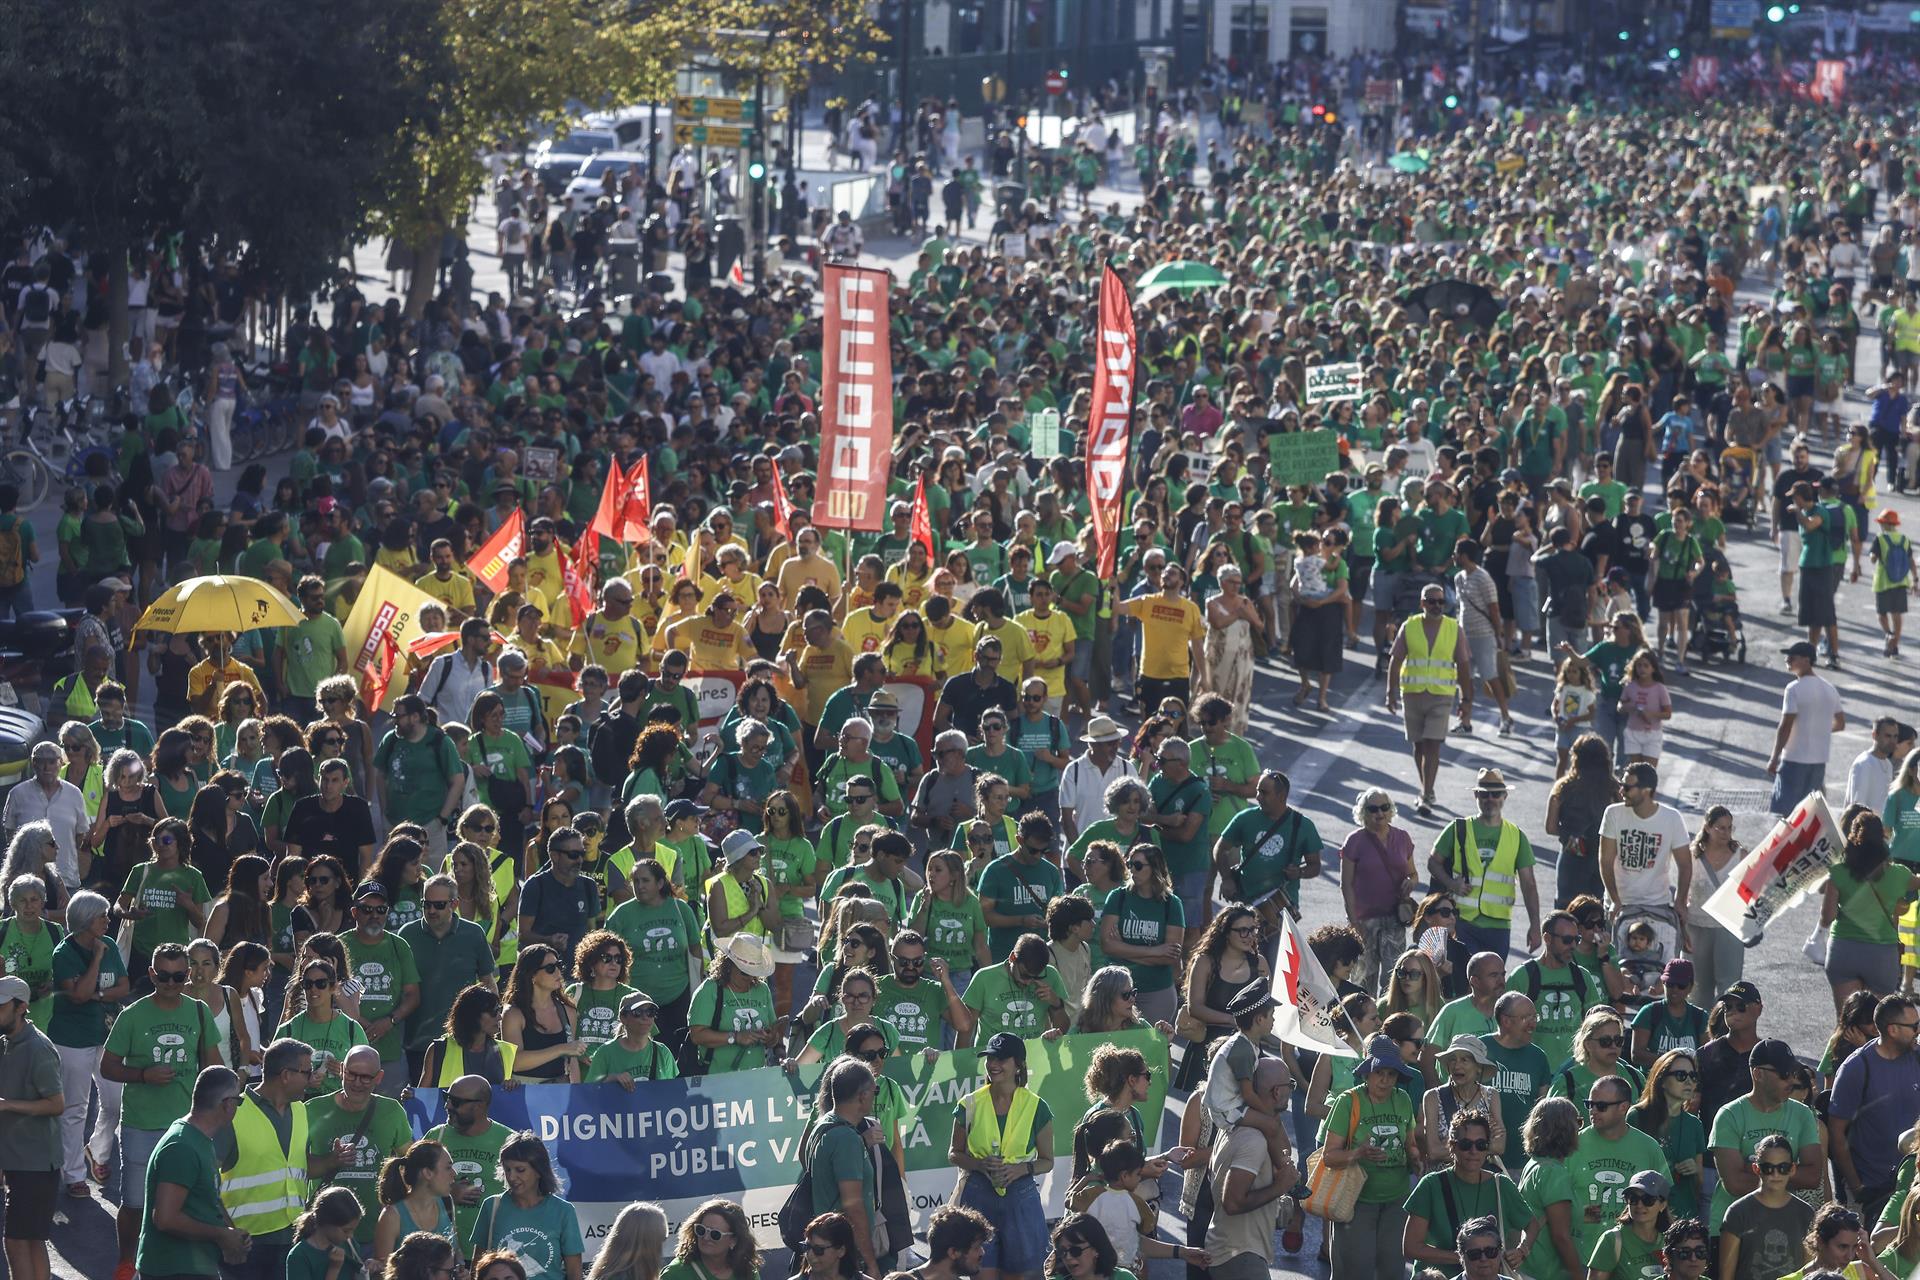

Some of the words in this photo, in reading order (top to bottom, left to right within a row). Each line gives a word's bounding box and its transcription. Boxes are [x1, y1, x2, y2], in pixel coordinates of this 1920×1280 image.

[831, 277, 875, 481] CCOO
[1122, 918, 1131, 935] LA
[1131, 919, 1159, 938] LLENGUA
[1659, 1035, 1668, 1050] LA
[1492, 1071, 1501, 1088] LA
[1502, 1071, 1531, 1091] LLENGUA
[541, 1101, 755, 1141] DIGNIFIQUEM
[650, 1140, 757, 1179] PÚBLIC
[1588, 1158, 1636, 1174] ESTIMEM
